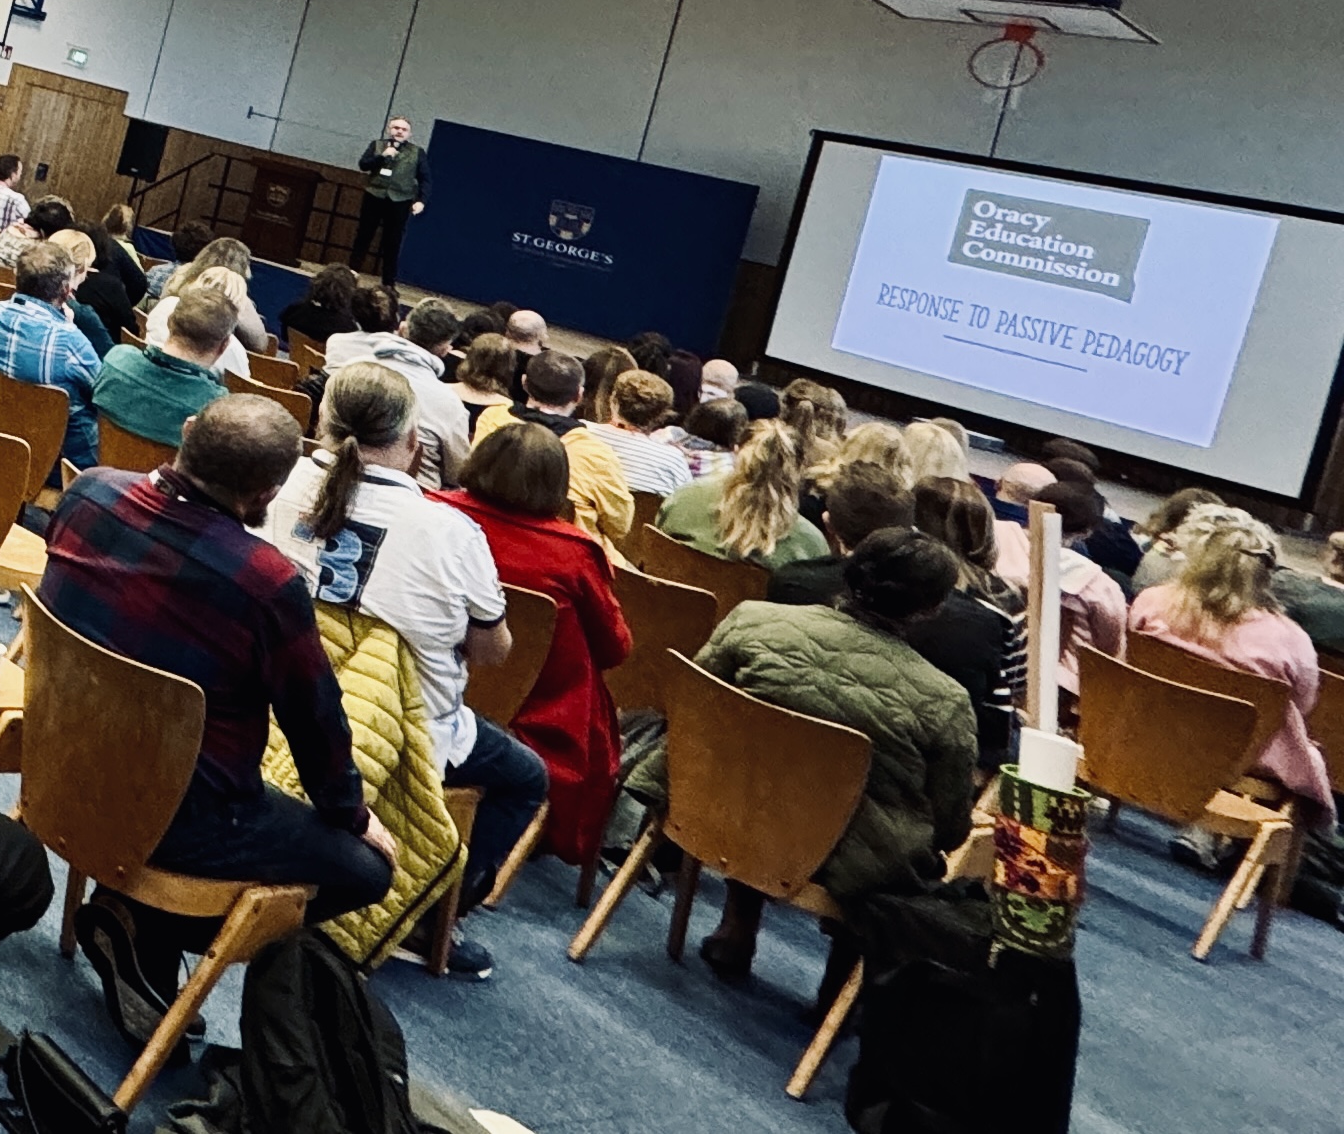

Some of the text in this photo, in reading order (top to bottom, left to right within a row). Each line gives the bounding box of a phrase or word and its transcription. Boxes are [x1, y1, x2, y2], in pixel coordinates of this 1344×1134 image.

[973, 200, 1051, 233] Oracy
[966, 219, 1095, 259] Education
[962, 240, 1120, 287] Commission
[876, 282, 1191, 376] RESPONSE TO PASSIVE PEDAGOGY
